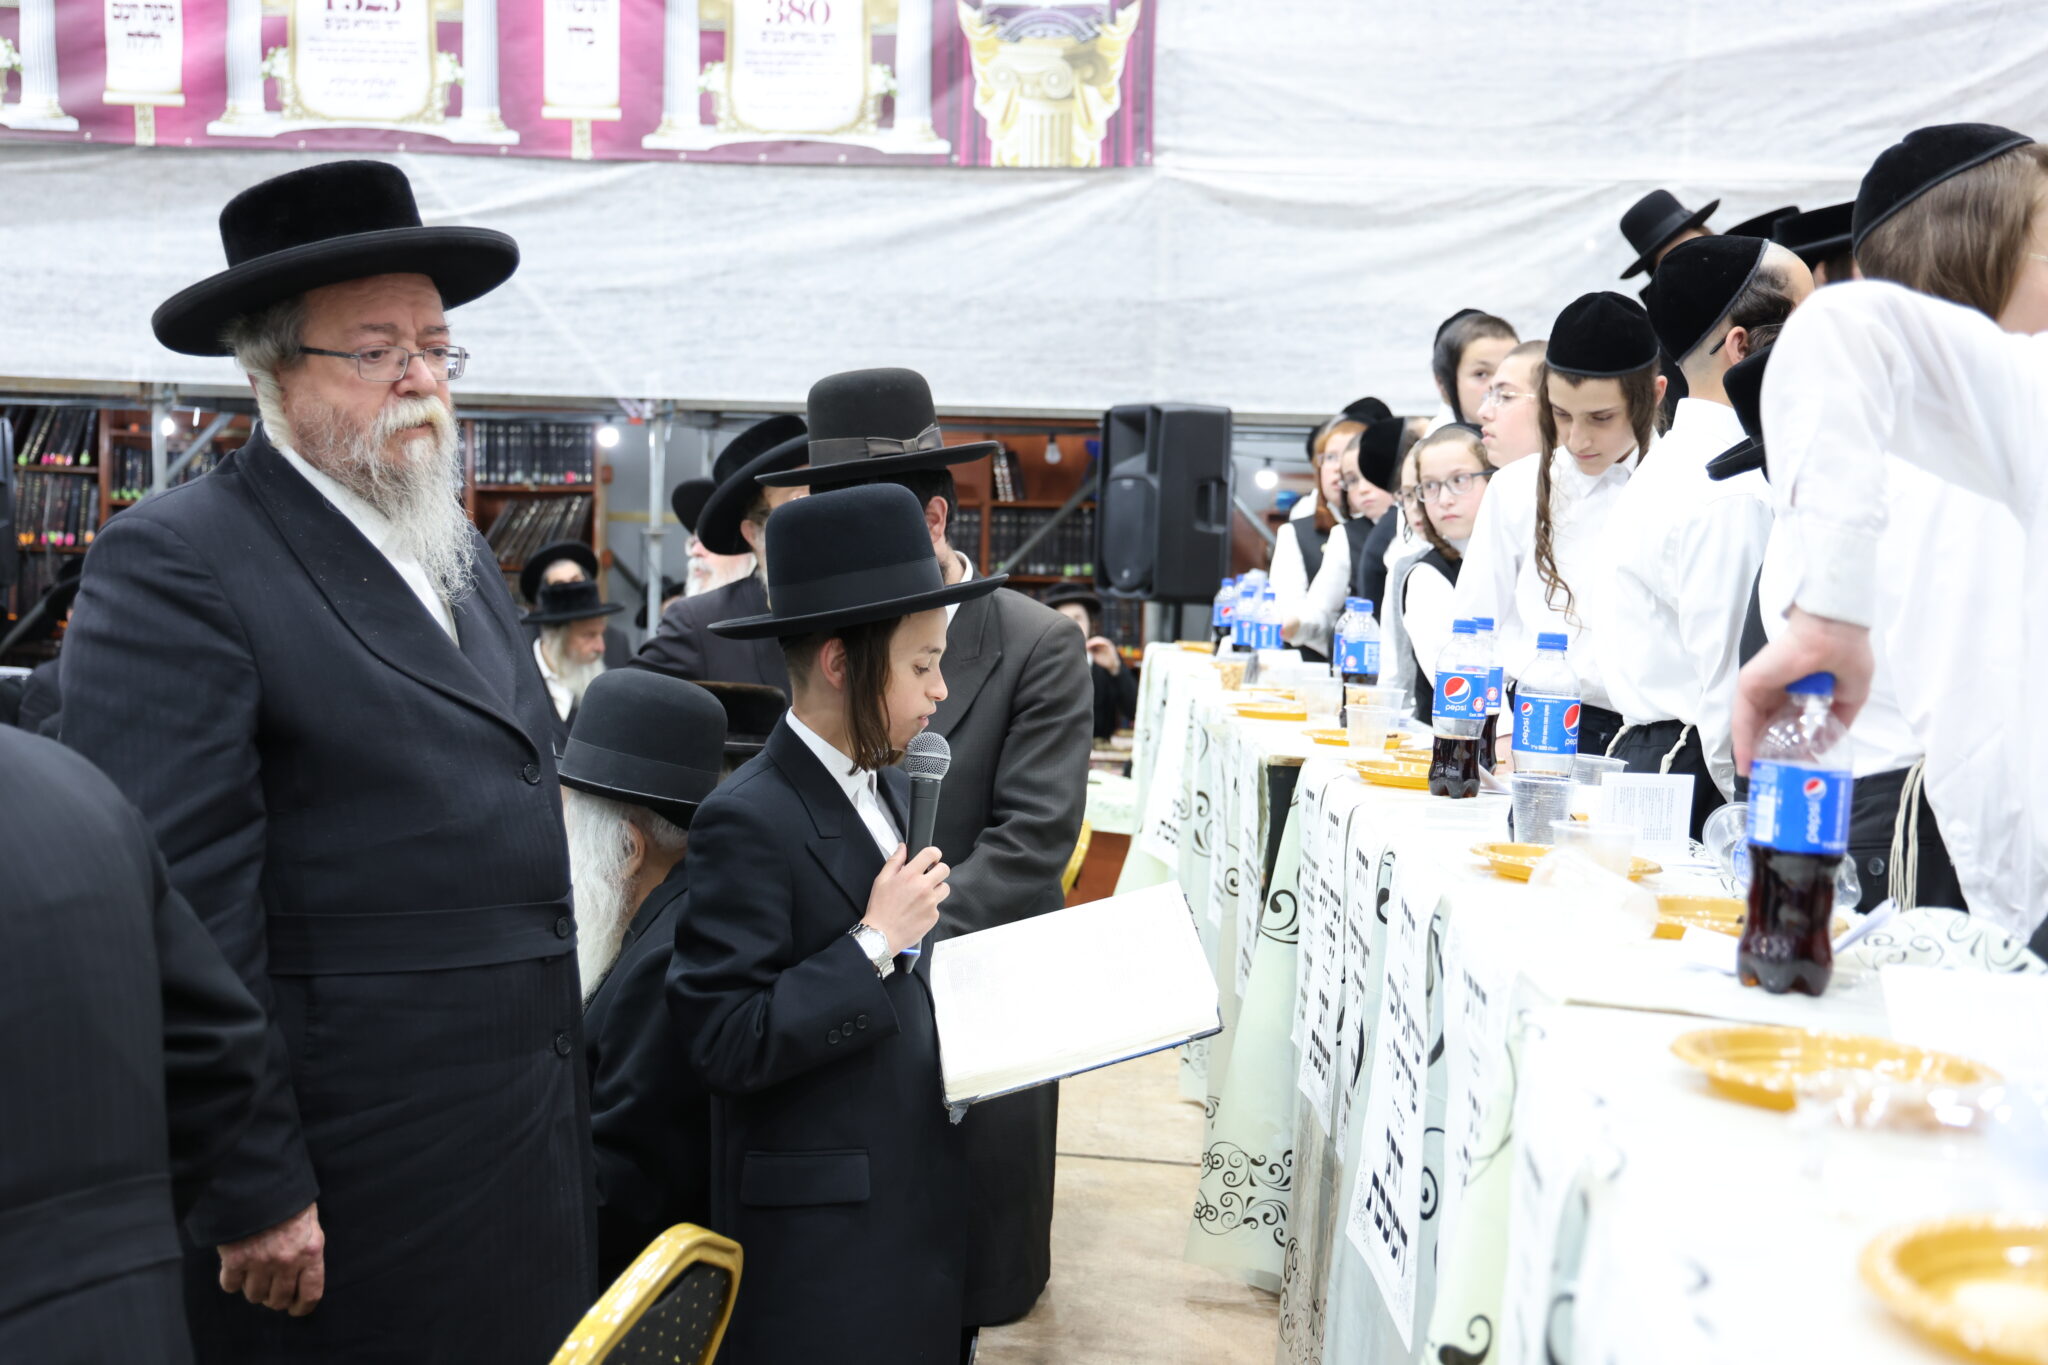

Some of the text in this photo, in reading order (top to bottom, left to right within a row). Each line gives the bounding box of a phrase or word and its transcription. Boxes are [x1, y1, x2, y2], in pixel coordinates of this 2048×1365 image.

[764, 0, 832, 24] 380
[1445, 704, 1467, 712] pepsi
[1521, 717, 1531, 746] pepsi
[1806, 799, 1822, 845] pepsi
[1384, 1126, 1403, 1196] חתן
[1366, 1171, 1408, 1275] המסכת
